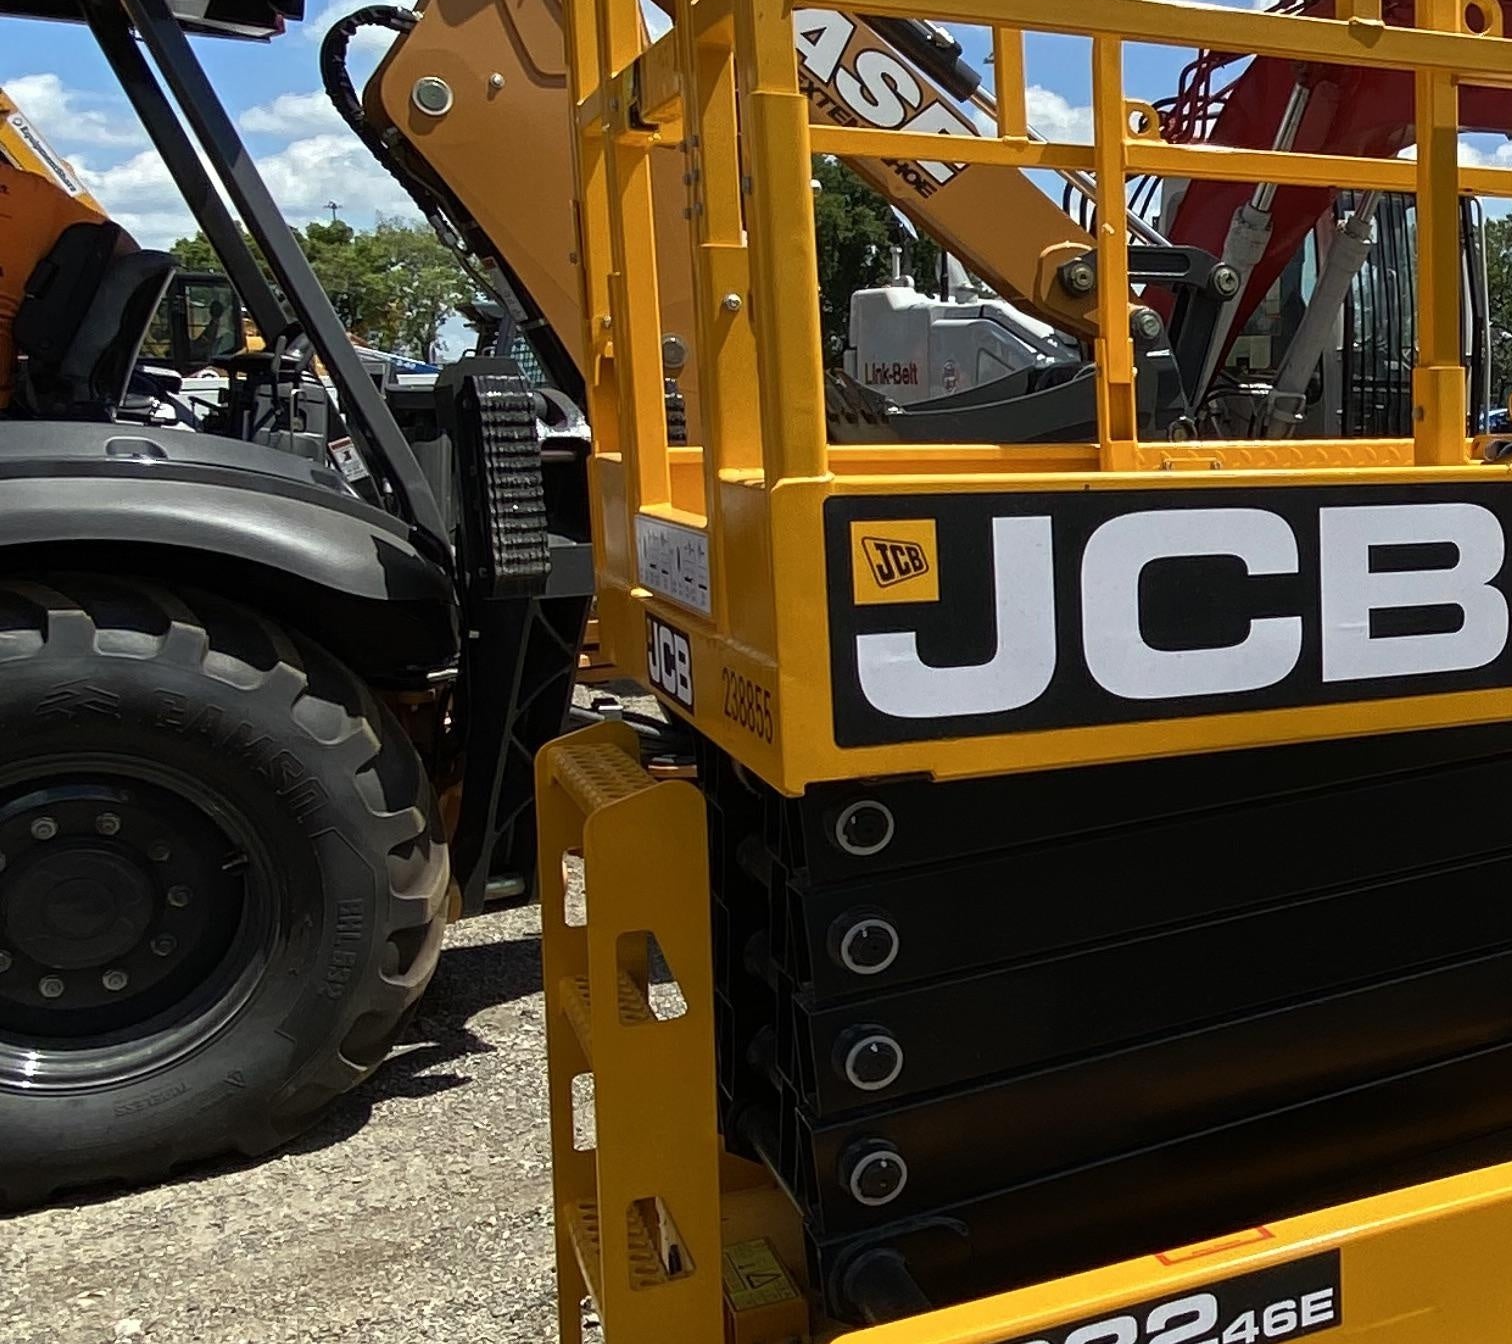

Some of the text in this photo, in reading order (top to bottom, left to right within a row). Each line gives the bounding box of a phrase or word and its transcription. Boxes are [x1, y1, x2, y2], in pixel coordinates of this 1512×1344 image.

[790, 8, 979, 187] ASE
[864, 362, 919, 385] Link-Belt
[872, 540, 926, 583] JCB
[857, 503, 1509, 718] JCB
[647, 616, 693, 706] JCB
[722, 666, 774, 745] 238855
